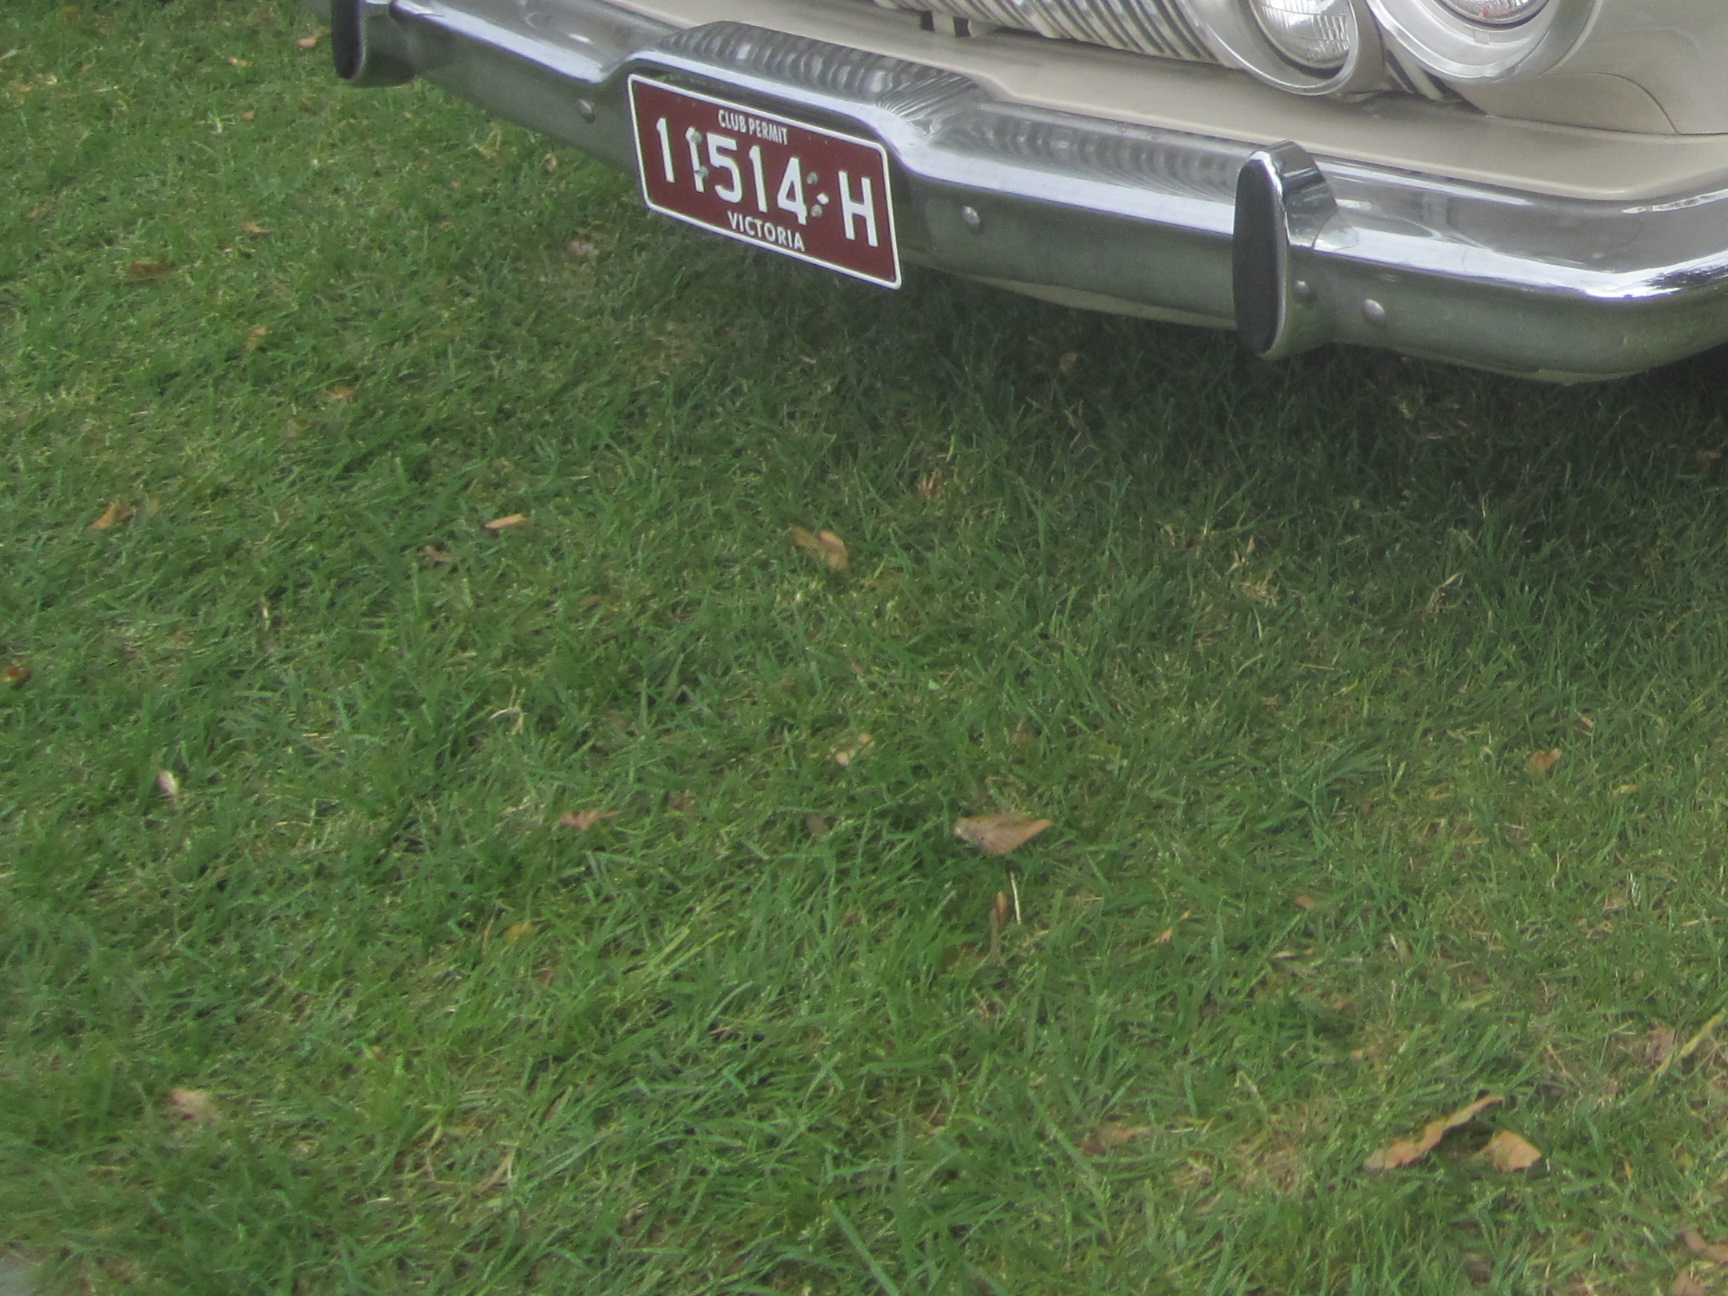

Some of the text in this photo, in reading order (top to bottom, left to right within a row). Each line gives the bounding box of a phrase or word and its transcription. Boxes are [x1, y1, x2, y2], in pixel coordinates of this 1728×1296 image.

[717, 109, 788, 146] CLUB PERMIT
[726, 210, 806, 252] VICTORIA
